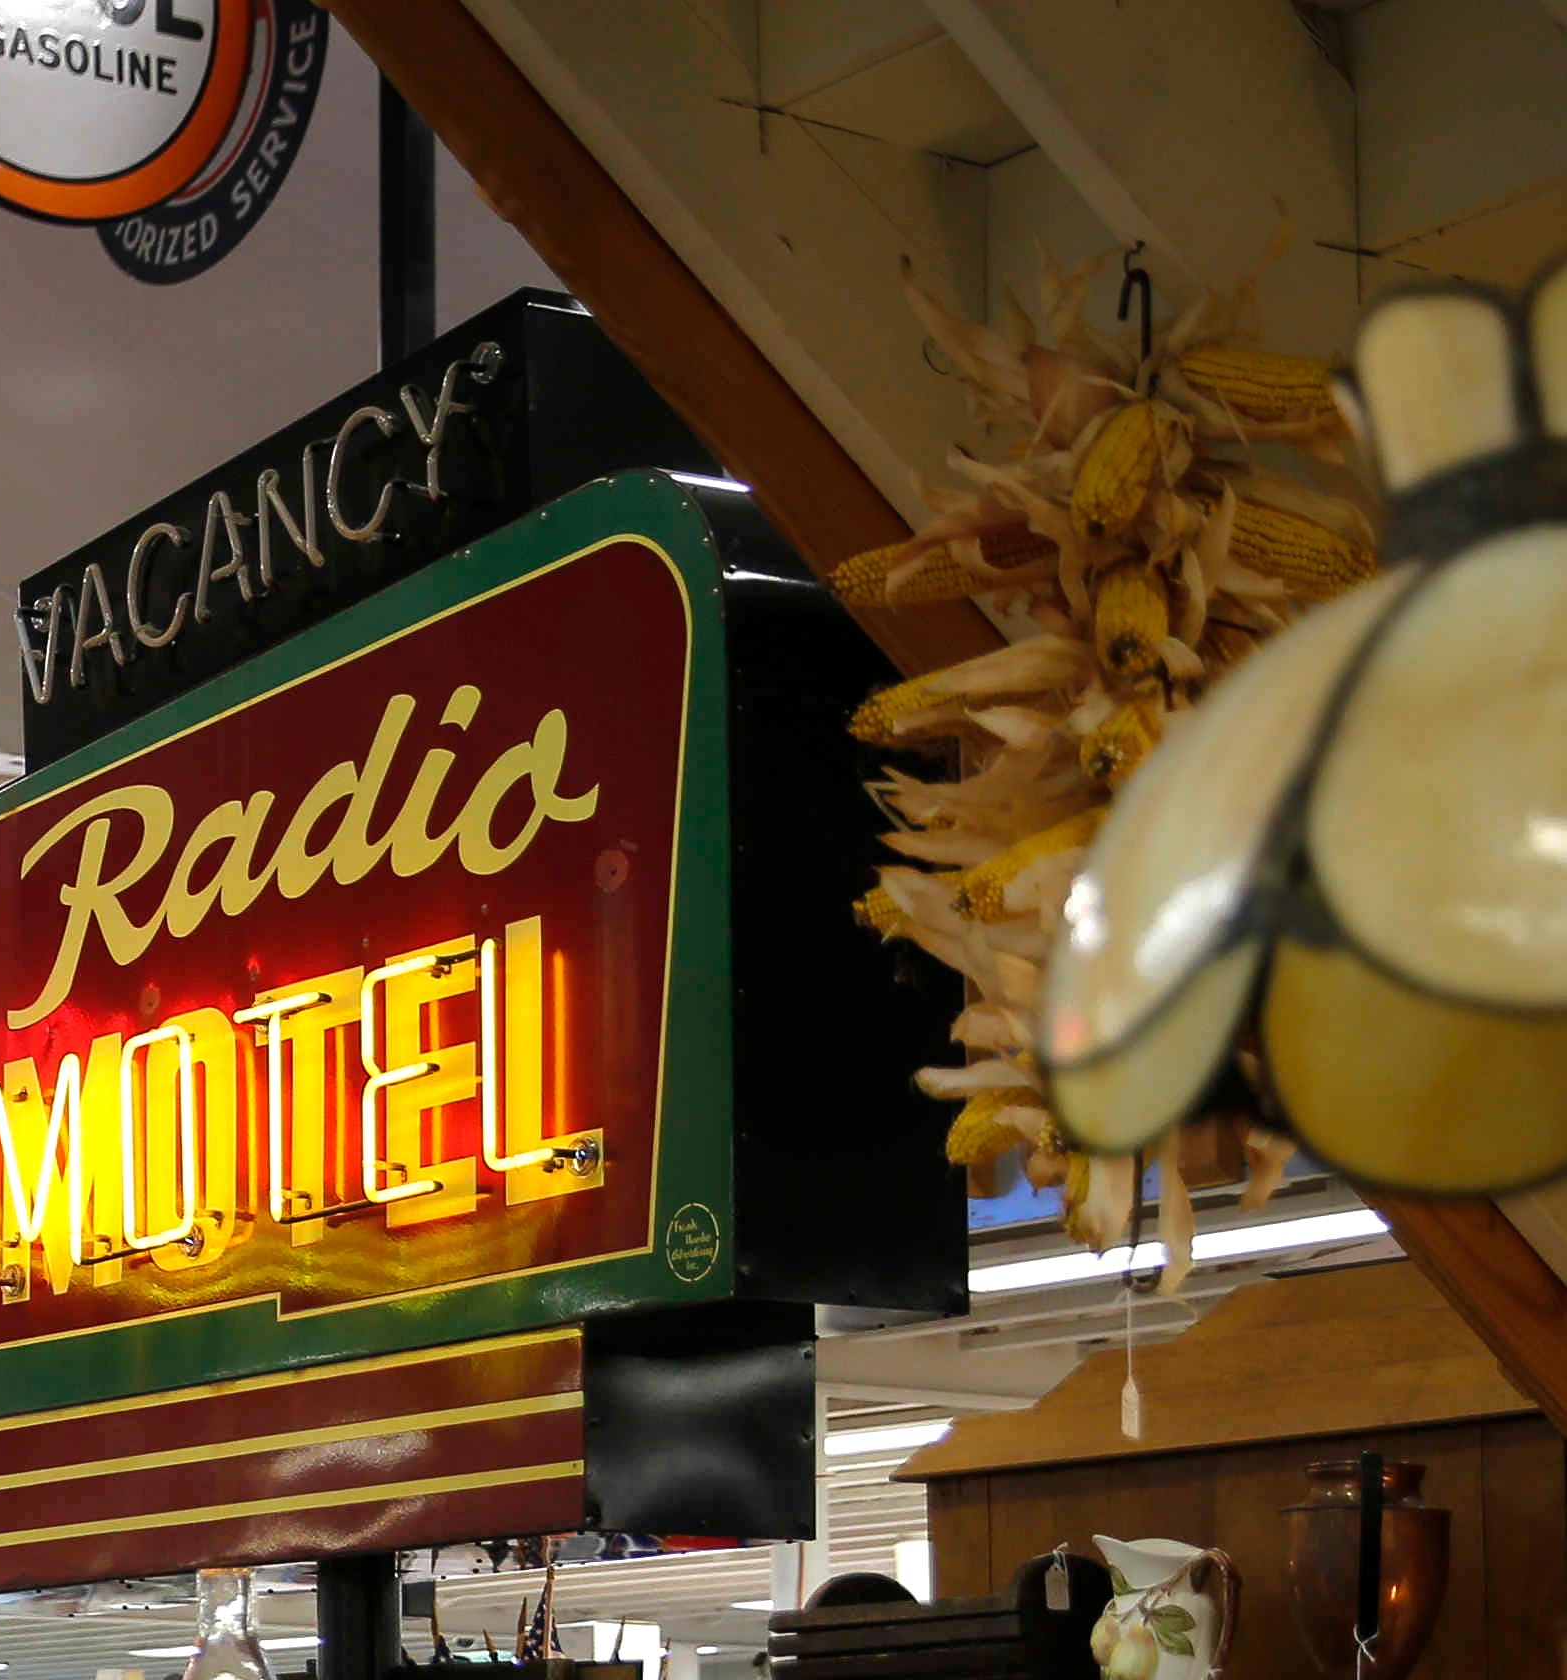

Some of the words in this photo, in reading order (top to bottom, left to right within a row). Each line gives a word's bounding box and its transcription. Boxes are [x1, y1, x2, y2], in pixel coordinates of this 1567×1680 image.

[231, 12, 317, 219] SERVICE
[13, 358, 487, 704] VACANCY
[7, 684, 599, 1029] Radio
